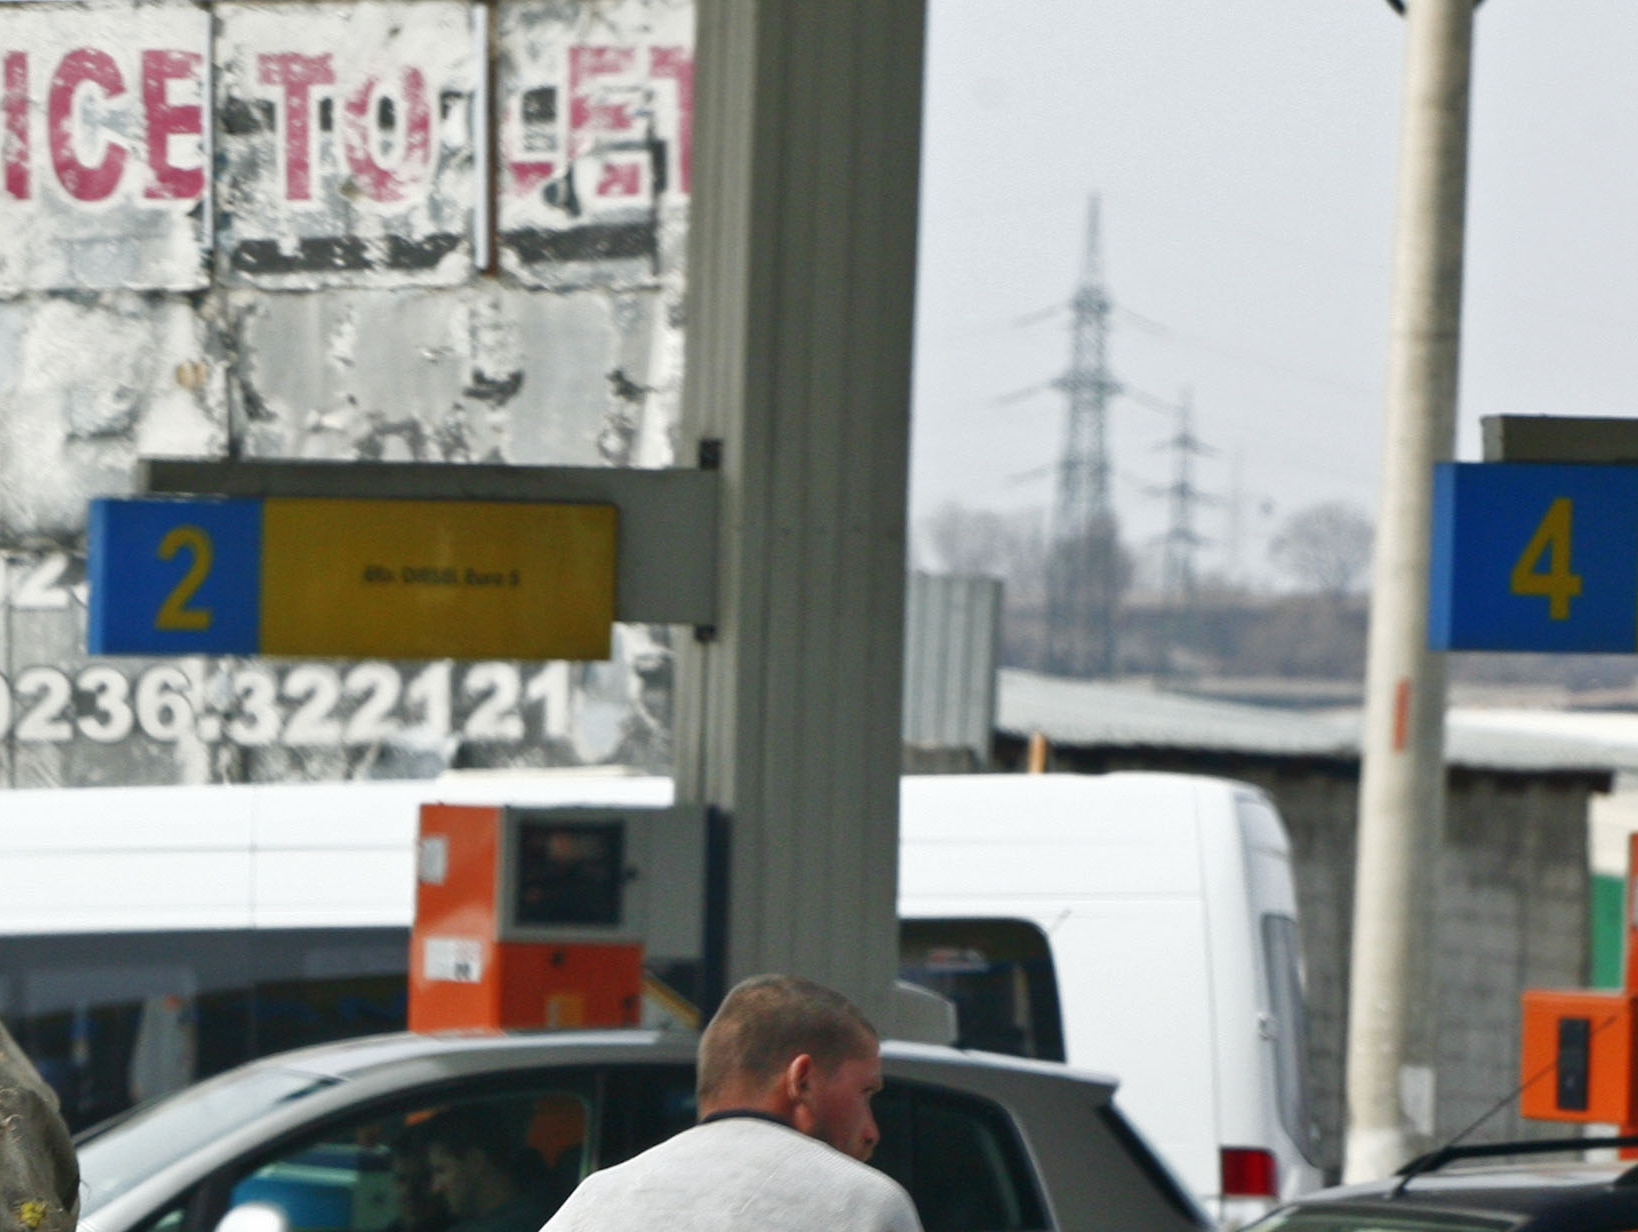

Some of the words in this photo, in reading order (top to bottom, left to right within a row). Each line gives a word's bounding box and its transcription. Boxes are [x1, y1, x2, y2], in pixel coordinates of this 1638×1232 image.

[256, 52, 430, 203] TO
[154, 524, 212, 631] 2
[1509, 496, 1583, 622] 4
